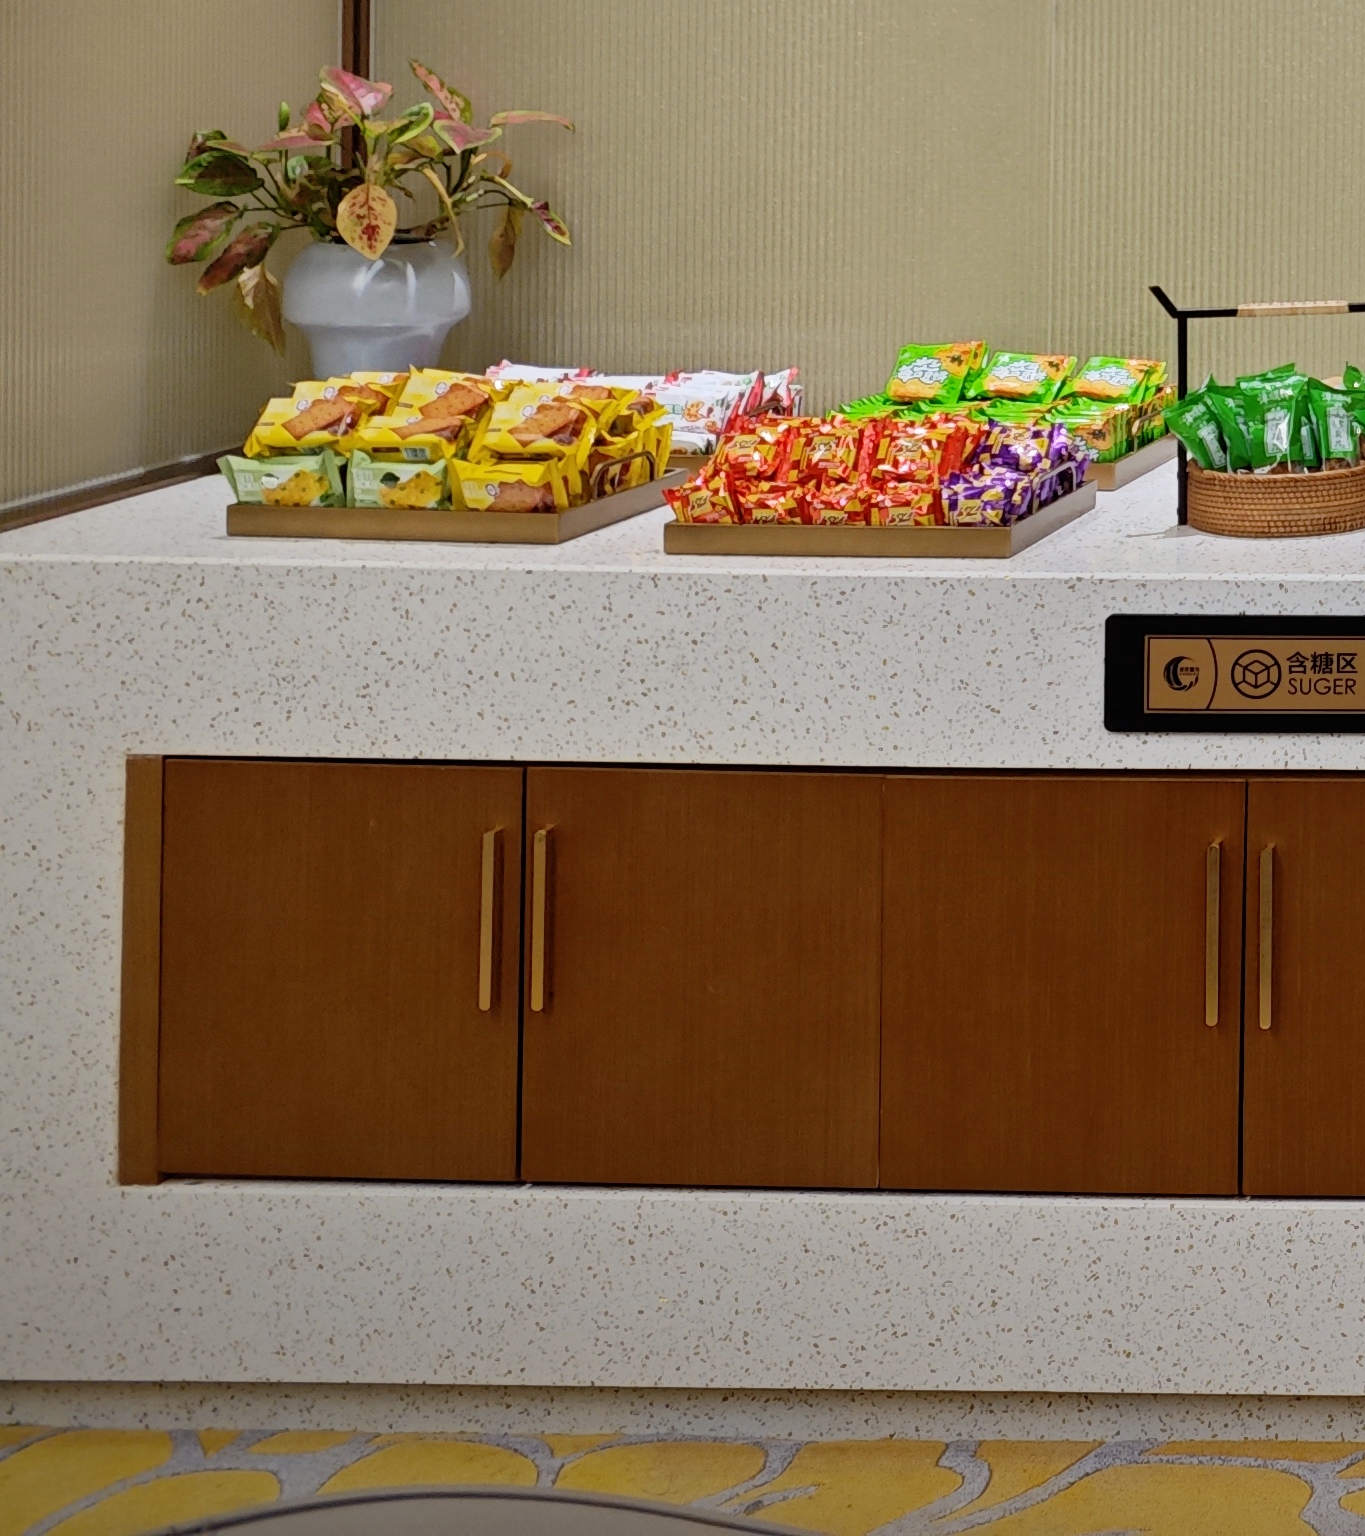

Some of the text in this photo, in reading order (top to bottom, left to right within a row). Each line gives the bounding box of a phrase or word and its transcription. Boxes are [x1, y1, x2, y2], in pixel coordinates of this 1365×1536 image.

[1285, 651, 1359, 676] 含糖区
[1287, 677, 1357, 696] SUGER
